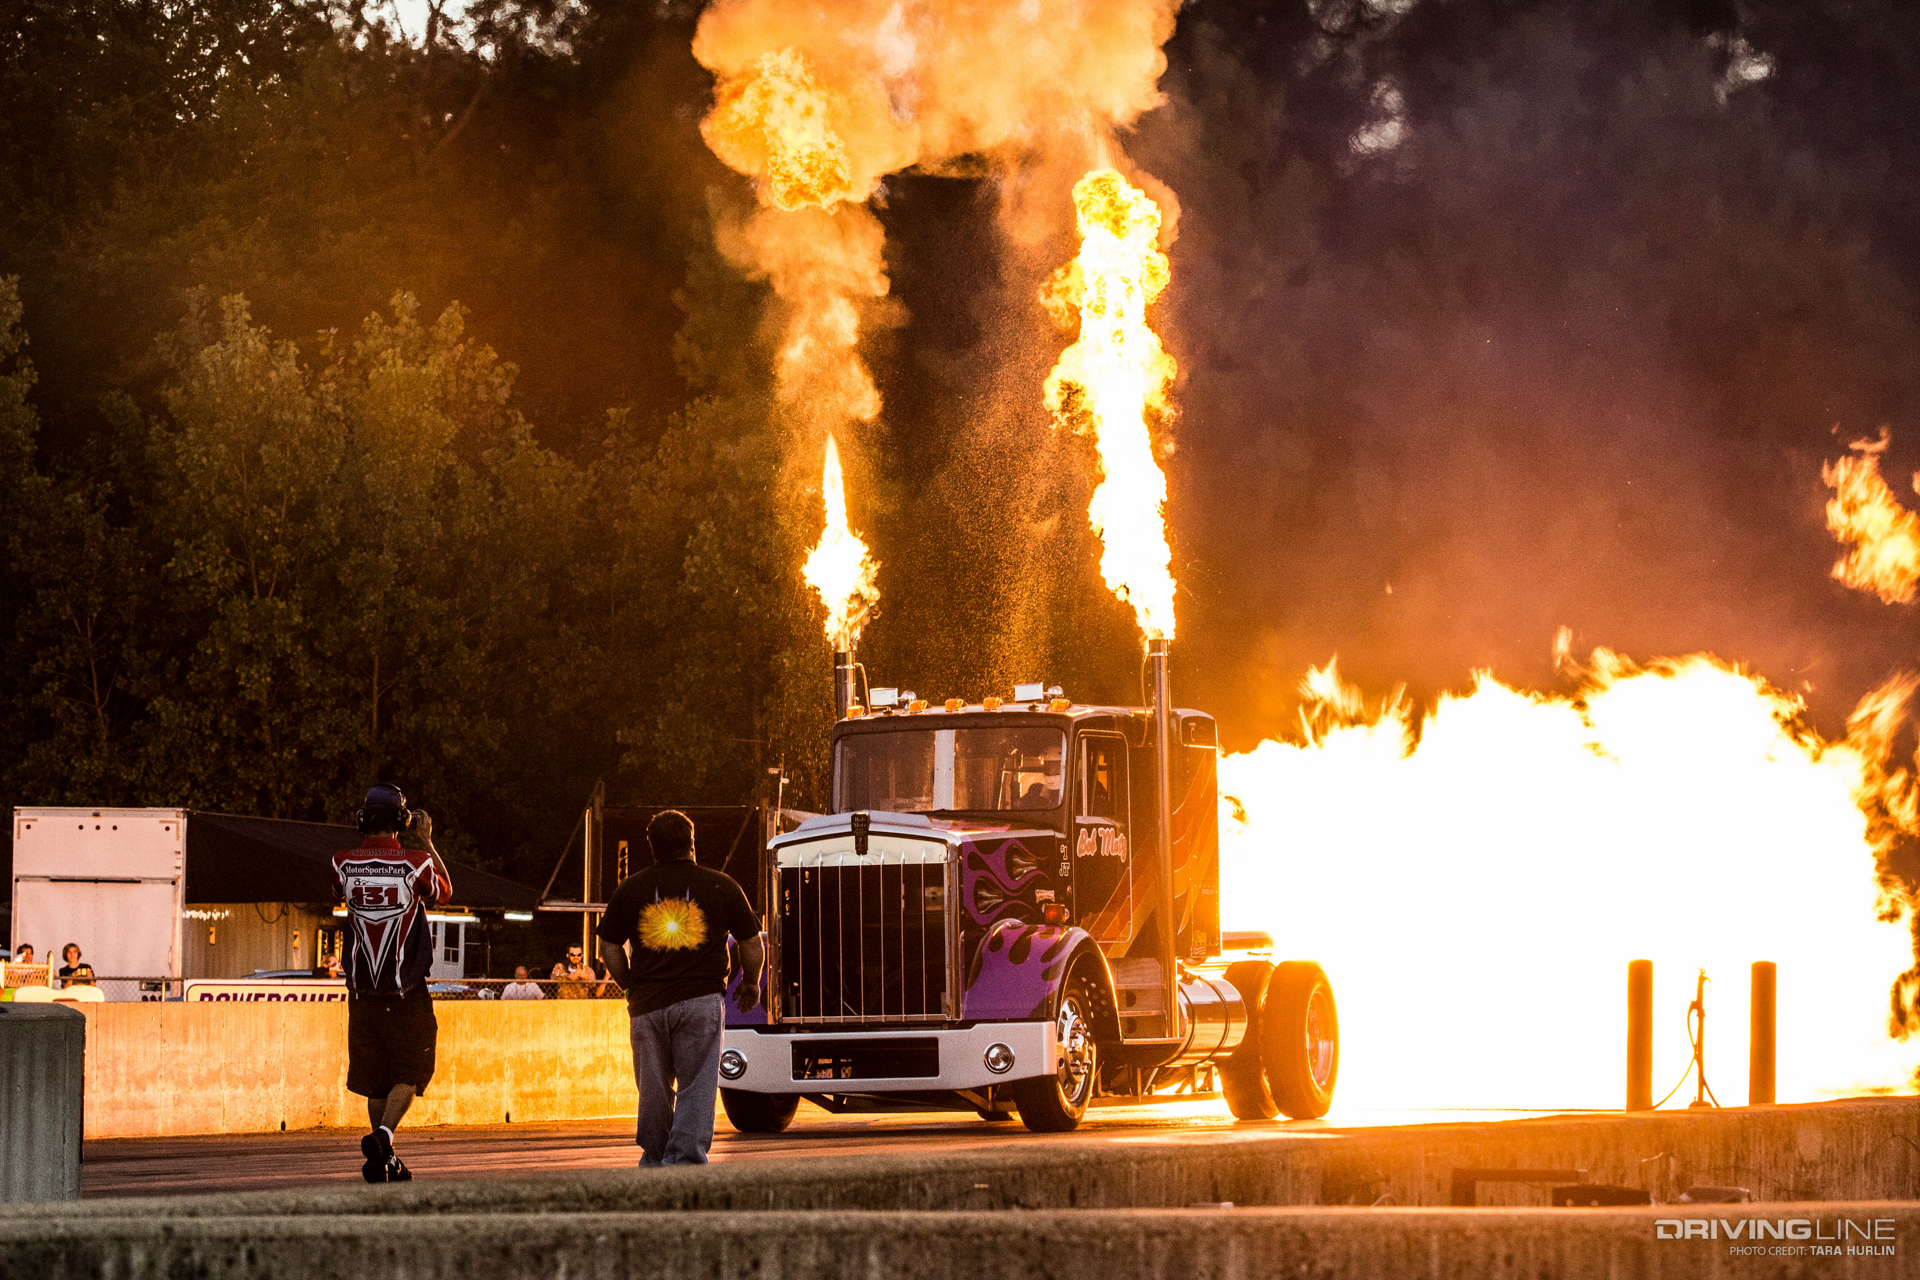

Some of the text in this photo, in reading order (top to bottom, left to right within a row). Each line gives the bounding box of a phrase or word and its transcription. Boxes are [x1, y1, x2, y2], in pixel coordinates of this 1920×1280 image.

[1077, 828, 1097, 858] Bob
[346, 866, 406, 875] MotorSportsPark
[351, 886, 399, 906] 131
